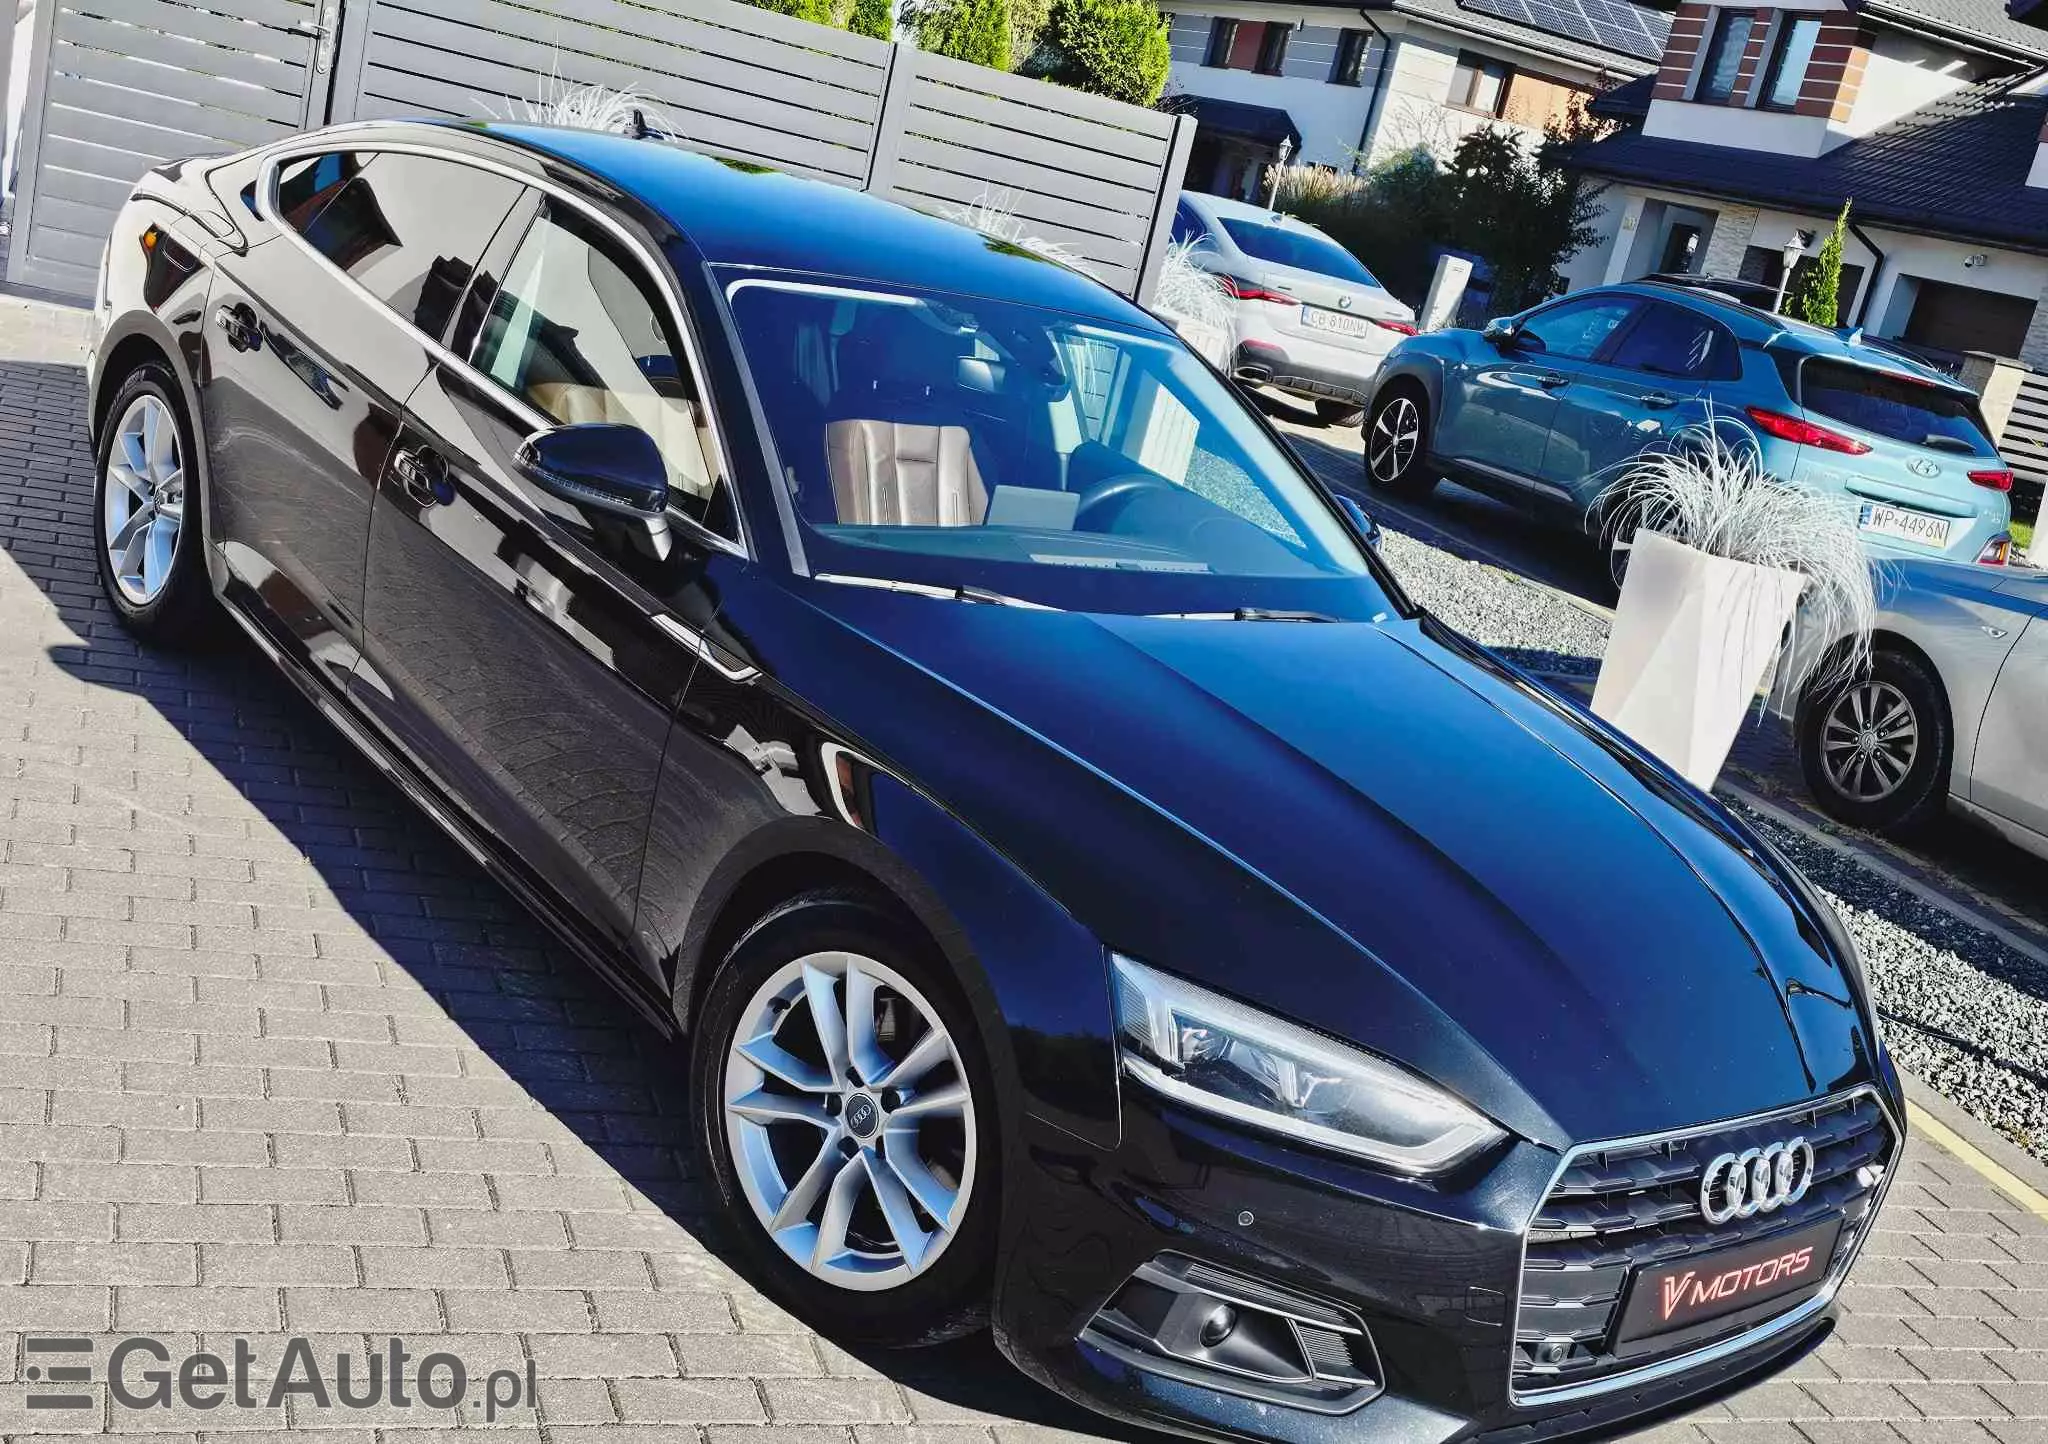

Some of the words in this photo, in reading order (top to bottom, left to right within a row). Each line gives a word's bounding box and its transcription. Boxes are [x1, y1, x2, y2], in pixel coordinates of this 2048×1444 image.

[1311, 311, 1326, 325] CB
[1873, 505, 1894, 526] WP
[1900, 515, 1946, 539] 4496N
[1690, 1246, 1813, 1306] MOTORS
